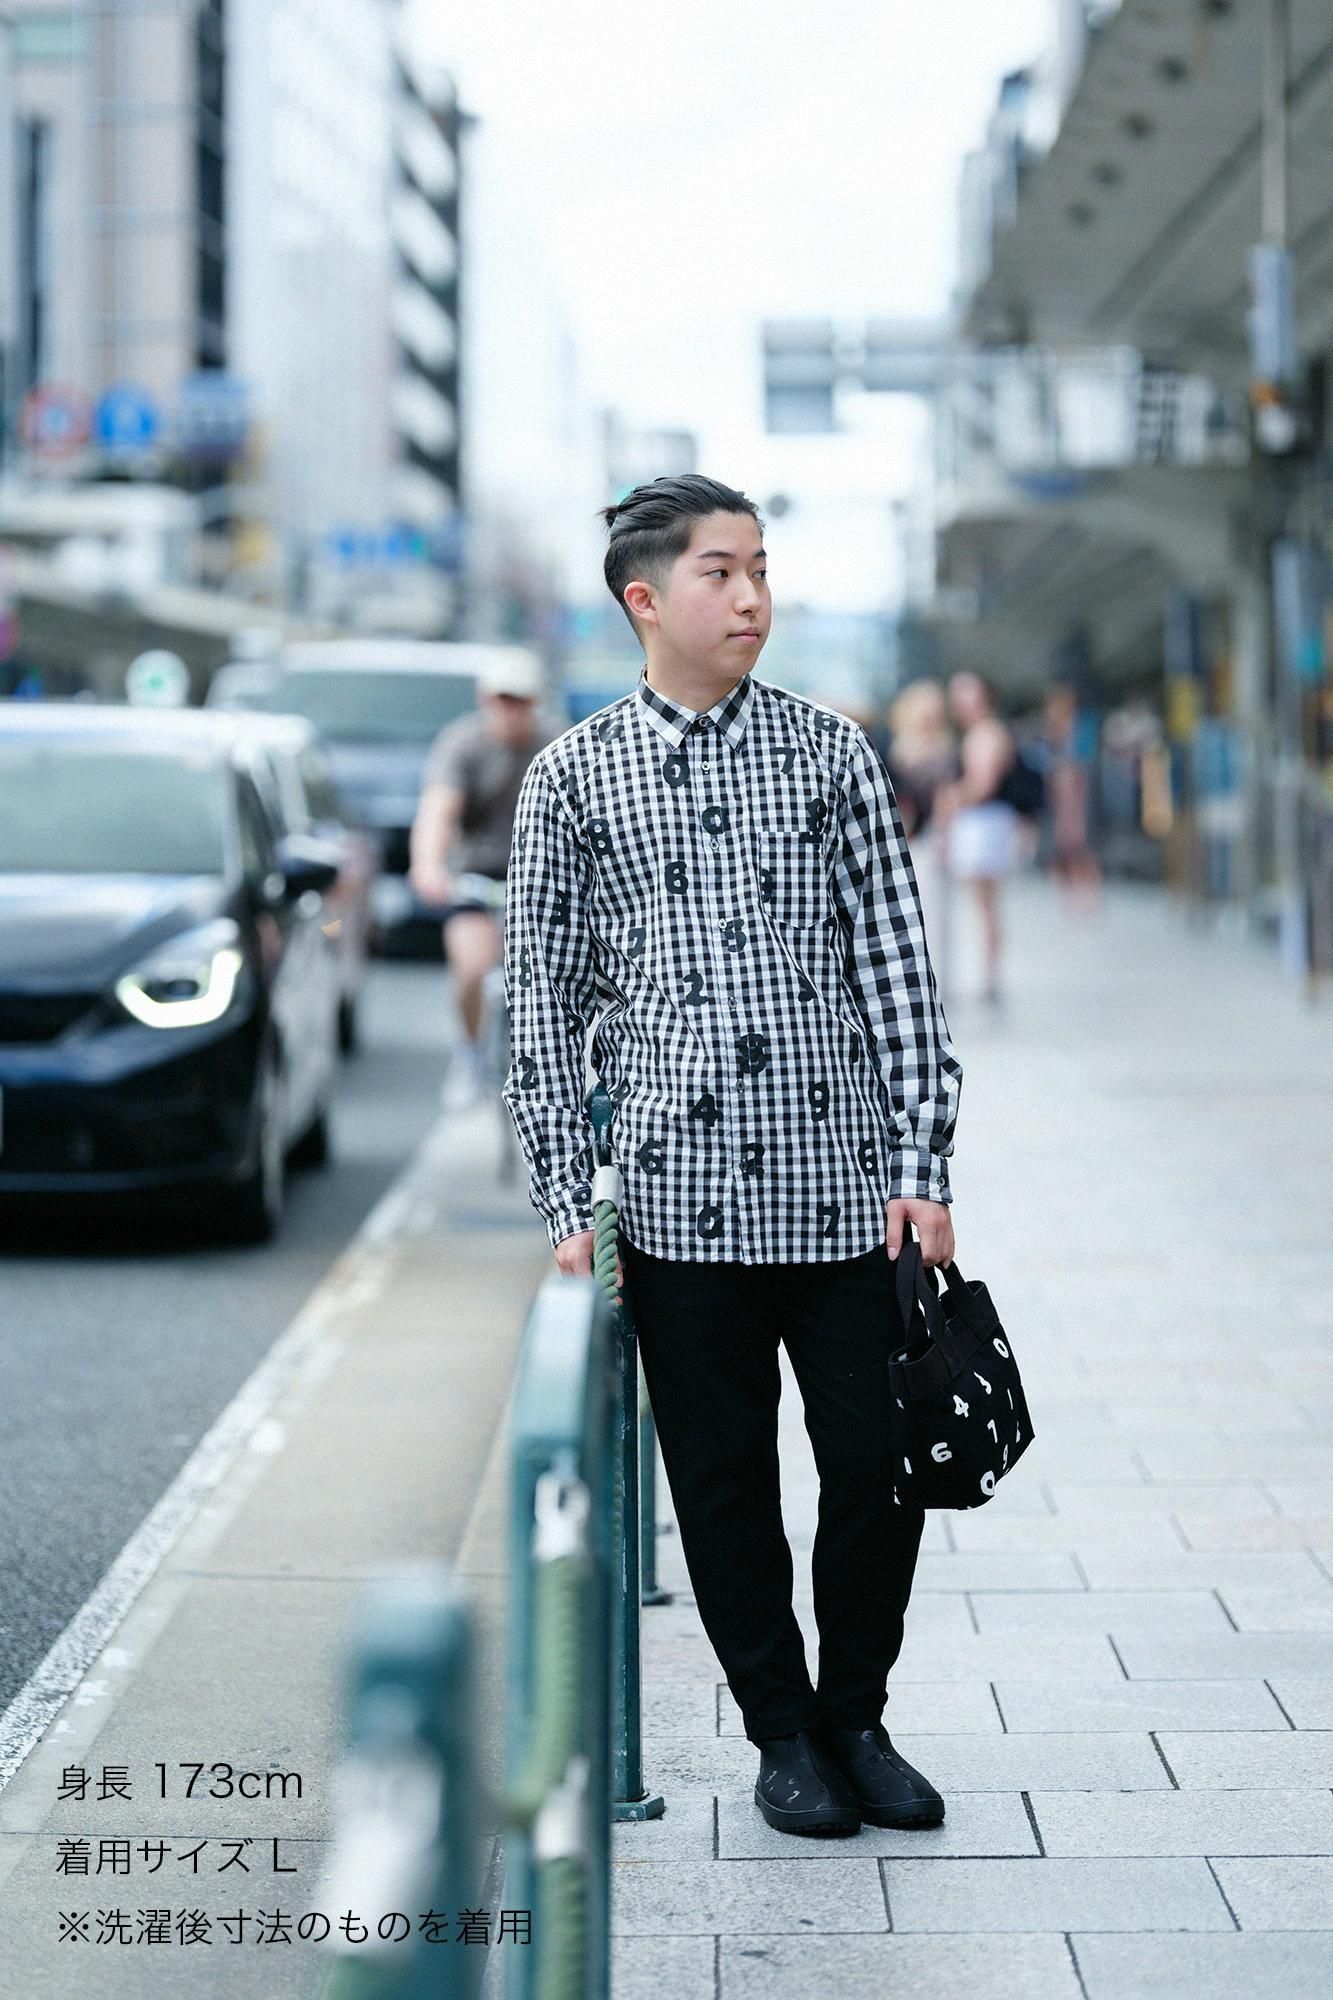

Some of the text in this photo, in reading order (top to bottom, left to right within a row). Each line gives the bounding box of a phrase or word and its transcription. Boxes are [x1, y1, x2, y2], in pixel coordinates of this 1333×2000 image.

[663, 755, 690, 787] 0
[770, 747, 796, 774] 7
[665, 861, 689, 895] 6
[683, 973, 709, 1006] 2
[688, 1093, 723, 1127] 4
[808, 1081, 829, 1122] 9
[639, 1138, 663, 1176] 6
[858, 1139, 878, 1177] 6
[697, 1206, 725, 1240] 0
[817, 1200, 841, 1238] 7
[993, 1338, 1009, 1359] 0
[953, 1394, 969, 1418] 4
[987, 1419, 998, 1444] 1
[931, 1442, 952, 1463] 6
